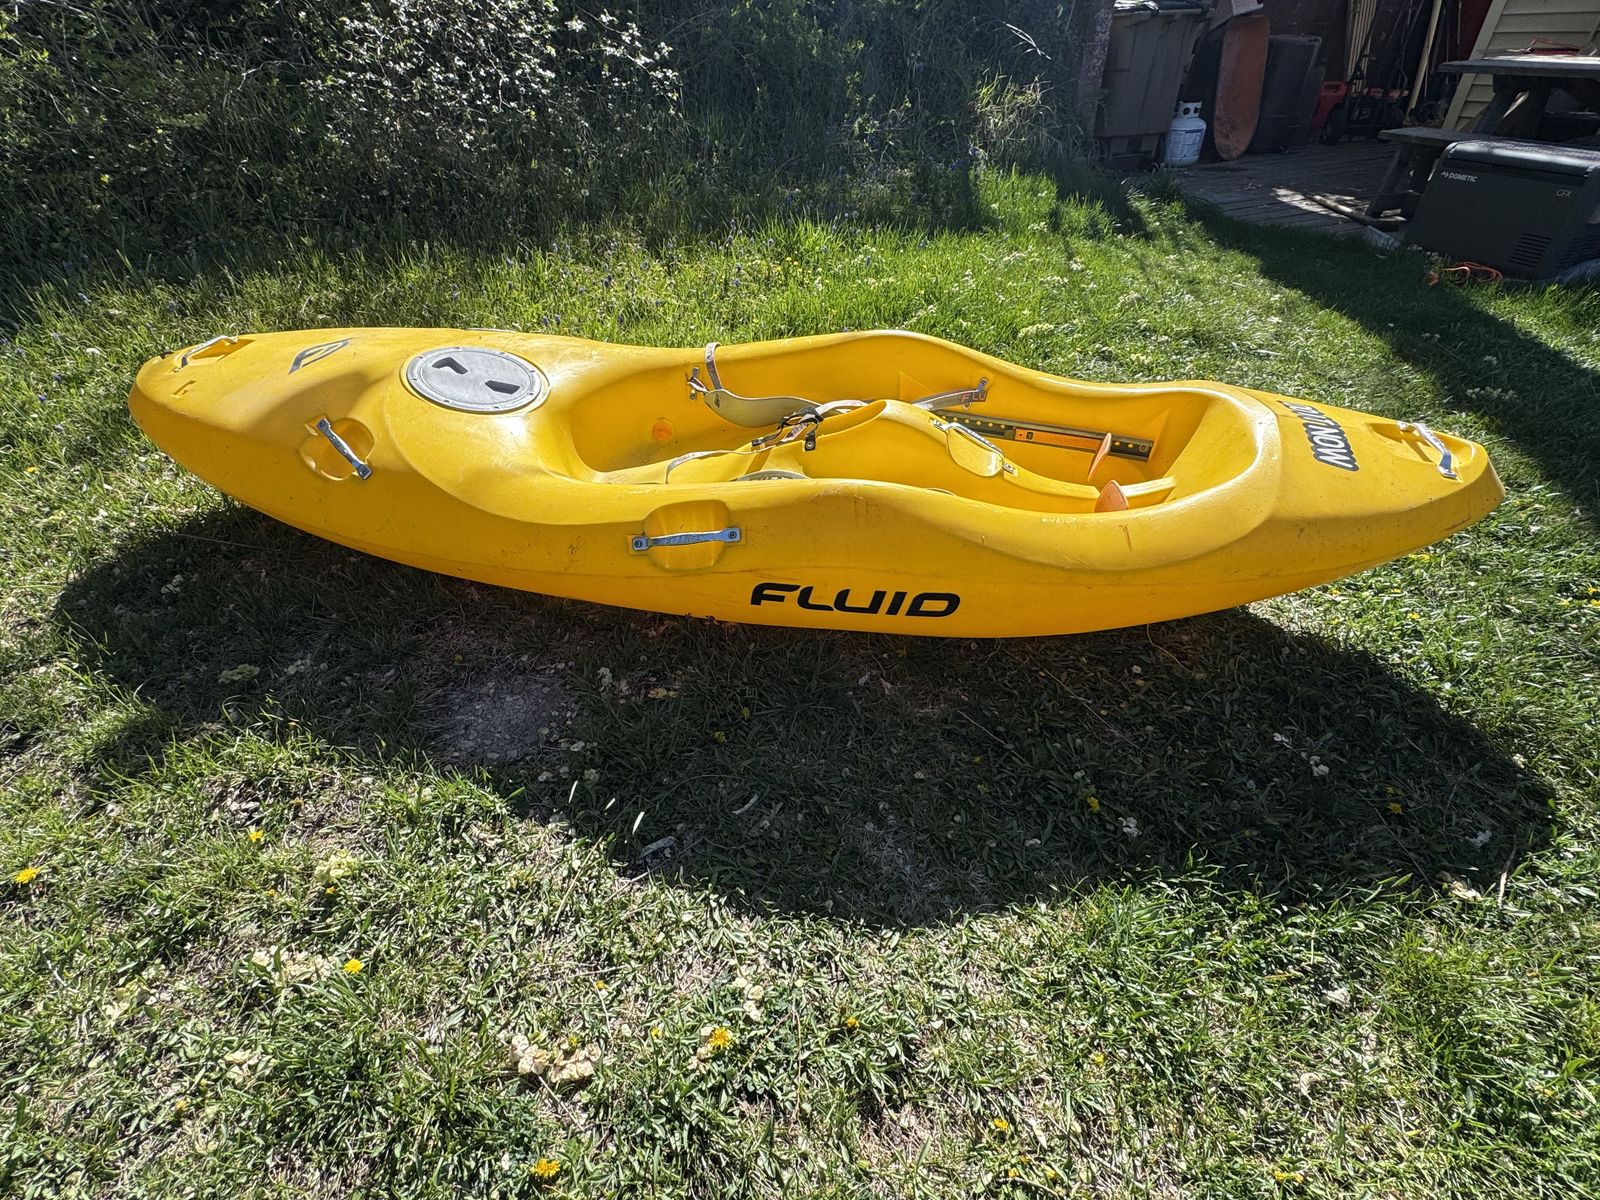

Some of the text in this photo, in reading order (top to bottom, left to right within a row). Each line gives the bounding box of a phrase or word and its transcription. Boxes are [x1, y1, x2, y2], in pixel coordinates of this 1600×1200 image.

[1448, 172, 1478, 183] DOMETIC
[1304, 423, 1357, 470] NOW
[750, 582, 961, 618] FLUID
